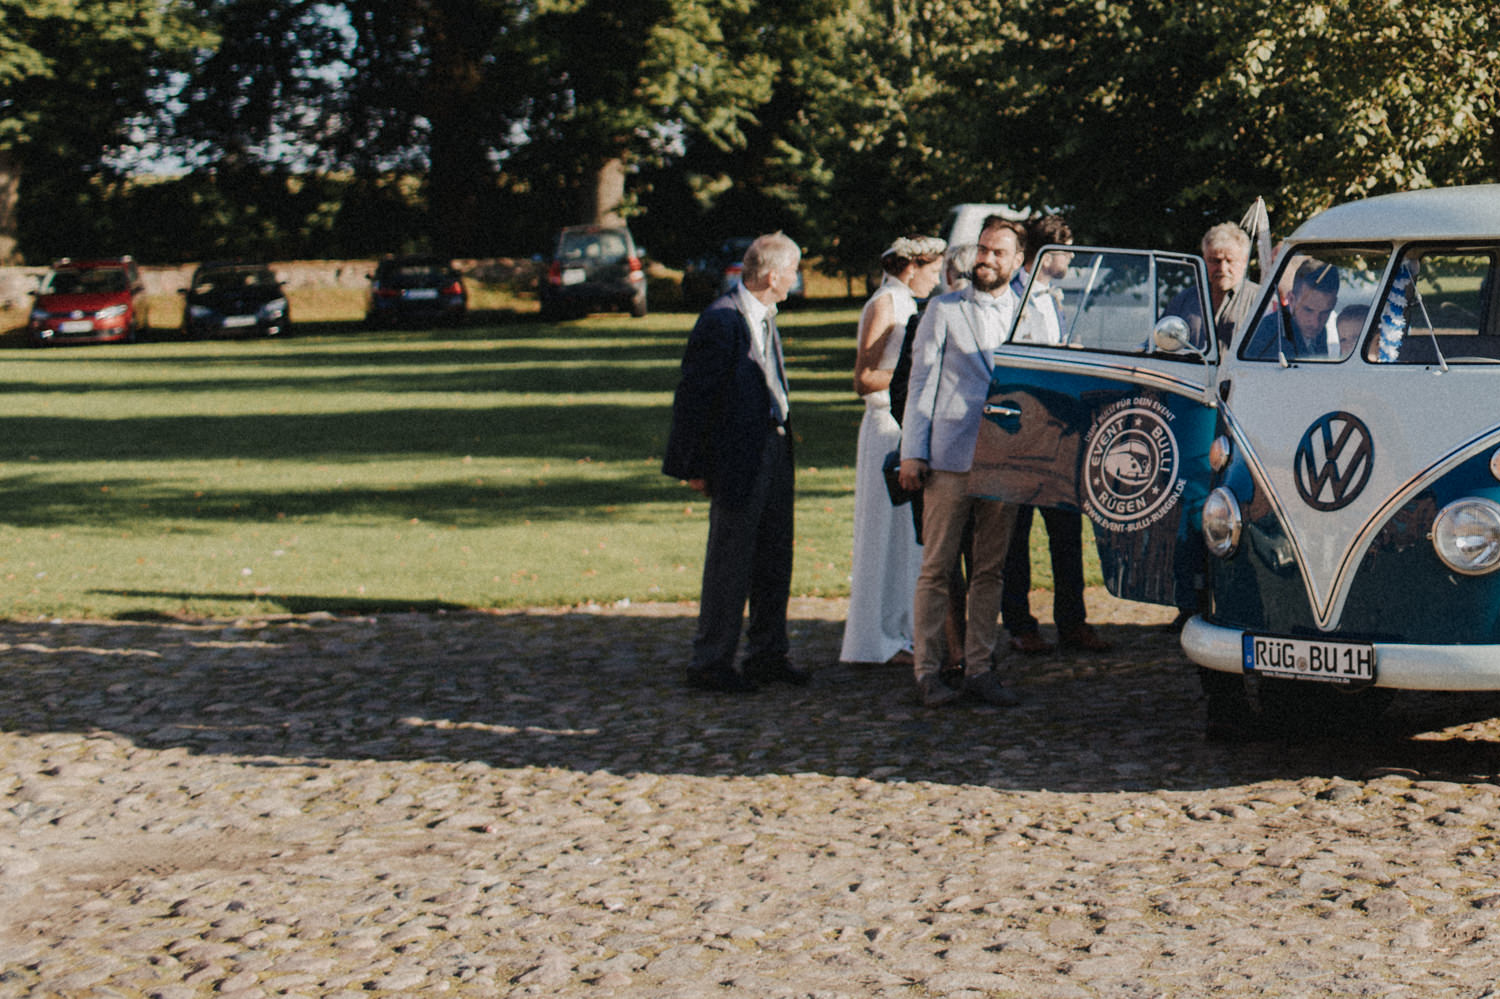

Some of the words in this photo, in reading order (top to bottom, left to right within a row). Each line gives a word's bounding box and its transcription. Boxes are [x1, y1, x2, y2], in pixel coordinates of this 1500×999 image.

[1116, 397, 1131, 410] FÜR
[1133, 396, 1152, 406] DEIN
[1152, 401, 1176, 422] EVENT
[1091, 418, 1126, 466] EVENT
[1151, 425, 1172, 472] BULLI
[1295, 412, 1374, 511] VW
[1084, 478, 1188, 532] WWW.EVENT-BULLI-RUEGEN.DE
[1098, 490, 1147, 514] RÜGEN
[1255, 640, 1296, 669] RÜG
[1309, 645, 1338, 674] BU
[1343, 648, 1371, 677] 1H
